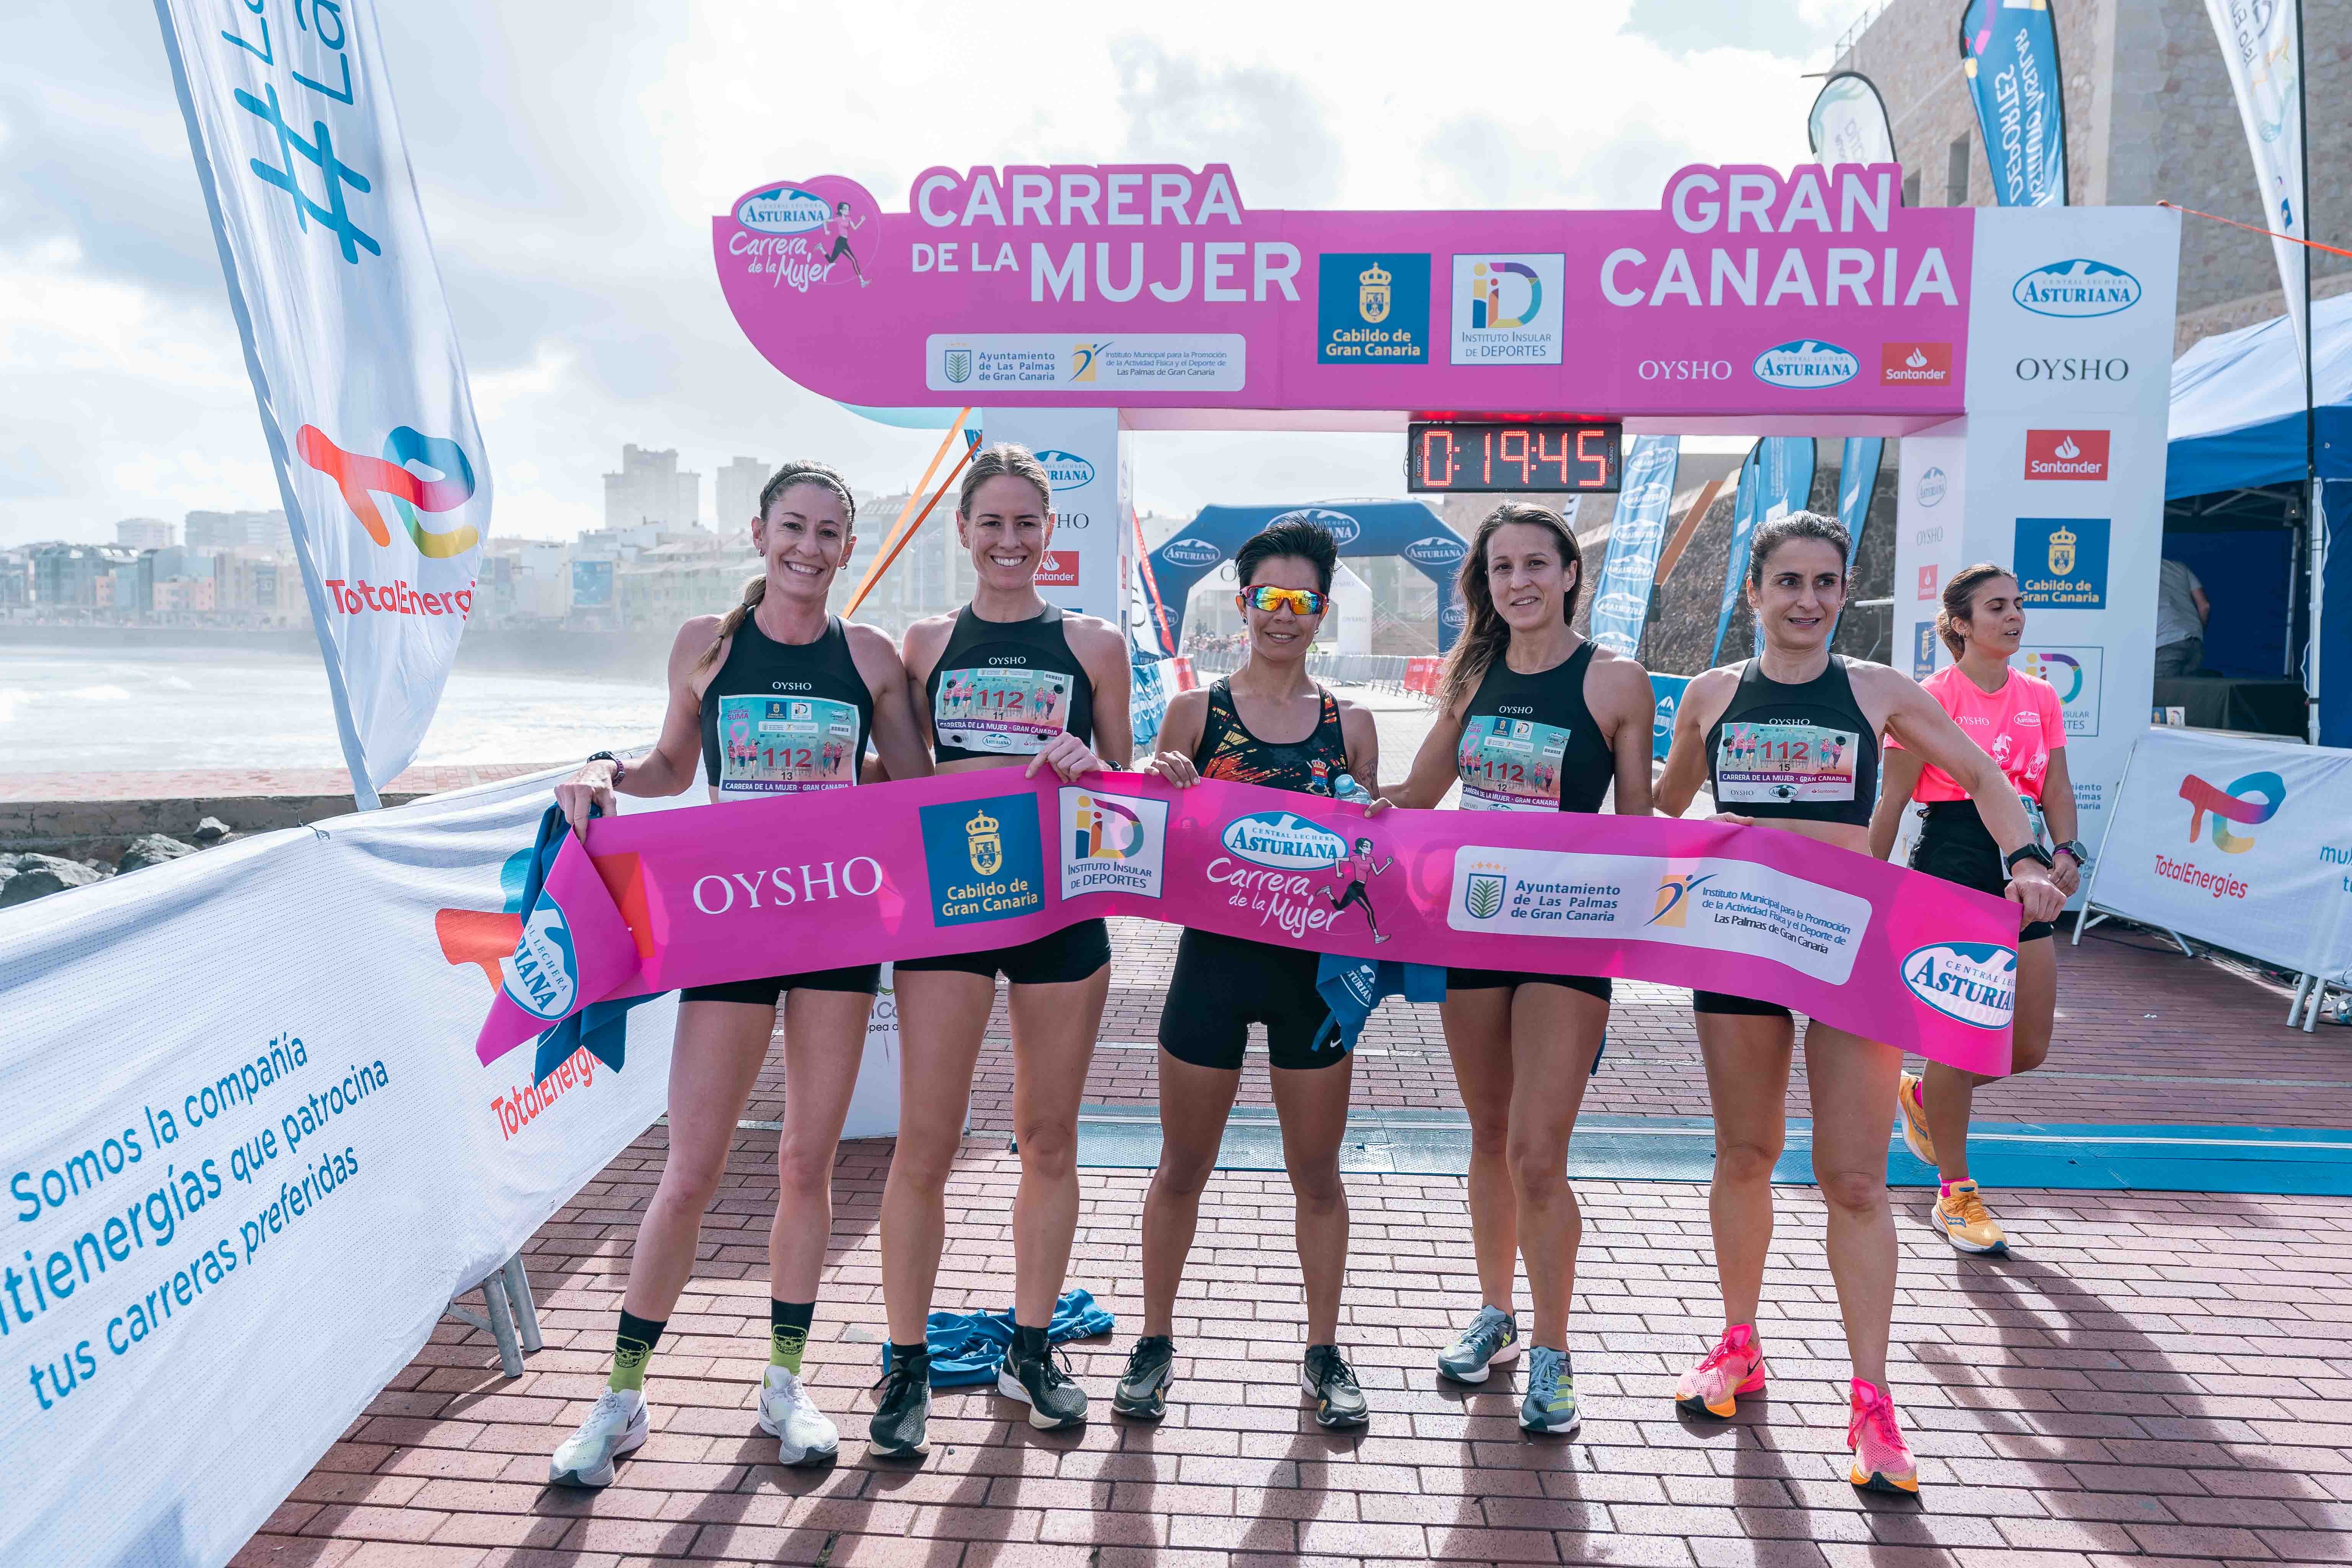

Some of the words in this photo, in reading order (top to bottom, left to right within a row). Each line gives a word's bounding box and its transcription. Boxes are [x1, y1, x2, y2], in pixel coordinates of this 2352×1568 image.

[918, 173, 1243, 227] CARRERA
[1672, 173, 1891, 234] GRAN
[745, 206, 824, 222] ASTURIANA
[729, 230, 807, 256] Carrera
[748, 256, 763, 273] de
[766, 256, 776, 273] la
[773, 252, 836, 293] Mujer
[912, 242, 959, 273] DE
[971, 242, 1019, 272] LA
[1031, 241, 1302, 303] MUJER
[1600, 247, 1959, 307] CANARIA
[2023, 281, 2132, 303] ASTURIANA
[1332, 328, 1390, 343] Cabildo
[1392, 328, 1411, 342] de
[1462, 332, 1509, 342] INSTITUTO
[1512, 332, 1552, 342] INSULAR
[979, 351, 1055, 362] Ayuntamiento
[1326, 343, 1362, 356] Gran
[1364, 343, 1421, 356] Canaria
[1481, 345, 1547, 356] DEPORTES
[979, 362, 991, 370] de
[998, 362, 1014, 370] Las
[1019, 362, 1055, 370] Palmas
[1638, 360, 1733, 380] OYSHO
[1761, 358, 1851, 377] ASTURIANA
[1885, 368, 1946, 381] Santander
[2016, 358, 2129, 381] OYSHO
[979, 372, 991, 381] de
[993, 372, 1016, 381] Gran
[1019, 372, 1055, 381] Canaria
[2031, 460, 2102, 474] Santander
[1916, 526, 1943, 546] OYSHO
[1166, 548, 1216, 561] ASTURIANA
[1410, 547, 1462, 559] ASTURIANA
[2025, 579, 2073, 591] Cabildo
[2075, 579, 2092, 591] de
[2020, 591, 2049, 602] Gran
[2051, 591, 2099, 603] Canaria
[989, 656, 1026, 665] OYSHO
[772, 681, 812, 690] OYSHO
[977, 689, 1024, 709] 112
[993, 712, 1003, 720] 11
[1499, 706, 1533, 714] OYSHO
[986, 723, 1008, 731] MUJER
[1031, 727, 1057, 736] CANARIA
[1954, 716, 1990, 726] OYSHO
[763, 748, 812, 767] 112
[1761, 741, 1809, 760] 112
[781, 772, 793, 781] 13
[1484, 761, 1524, 782] 112
[1779, 763, 1790, 772] 15
[1463, 786, 1480, 796] CARRERA
[1492, 793, 1510, 802] MUJER
[1532, 798, 1559, 807] CANARIA
[1497, 783, 1507, 792] 12
[1230, 826, 1339, 860] ASTURIANA
[1252, 827, 1290, 839] CENTRAL
[1294, 833, 1335, 842] LECHERA
[1068, 861, 1110, 876] INSTITUTO
[1113, 861, 1152, 878] INSULAR
[1206, 857, 1311, 897] Carrera
[2154, 854, 2249, 899] TotalEnergies
[693, 856, 883, 915] OYSHO
[947, 880, 1006, 901] Cabildo
[1009, 877, 1028, 893] de
[1071, 879, 1080, 889] DE
[1083, 874, 1147, 889] DEPORTES
[1515, 880, 1621, 895] Ayuntamiento
[942, 899, 979, 917] Gran
[982, 892, 1039, 912] Canaria
[1513, 894, 1531, 905] de
[1539, 896, 1561, 907] Las
[1569, 897, 1618, 909] Palmas
[1702, 887, 1738, 899] Instituto
[1740, 891, 1780, 910] Municipal
[1780, 905, 1795, 916] para
[1797, 910, 1804, 919] la
[1805, 913, 1851, 935] Promoción
[1228, 889, 1247, 907] de
[1251, 891, 1265, 911] la
[1260, 892, 1346, 939] Mujer
[1511, 907, 1528, 918] de
[1530, 909, 1562, 920] Gran
[1566, 910, 1615, 922] Canaria
[1702, 899, 1714, 908] de
[1715, 900, 1724, 910] la
[1725, 901, 1768, 917] Actividad
[1786, 920, 1792, 929] y
[1793, 921, 1799, 930] el
[1800, 923, 1833, 941] Deporte
[1834, 935, 1847, 946] de
[1714, 913, 1730, 924] Las
[1731, 915, 1767, 931] Palmas
[1769, 924, 1780, 934] de
[1780, 928, 1797, 943] Gran
[1797, 936, 1829, 954] Canaria
[533, 938, 568, 992] LECHERA
[1945, 960, 1999, 983] CENTRAL
[10, 1127, 143, 1223] Somos
[144, 1105, 179, 1150] la
[184, 1031, 308, 1128] compañía
[230, 1127, 278, 1184] que
[281, 1060, 389, 1154] patrocina
[29, 1340, 96, 1411] tus
[106, 1238, 237, 1356] carreras
[239, 1146, 359, 1265] preferidas
